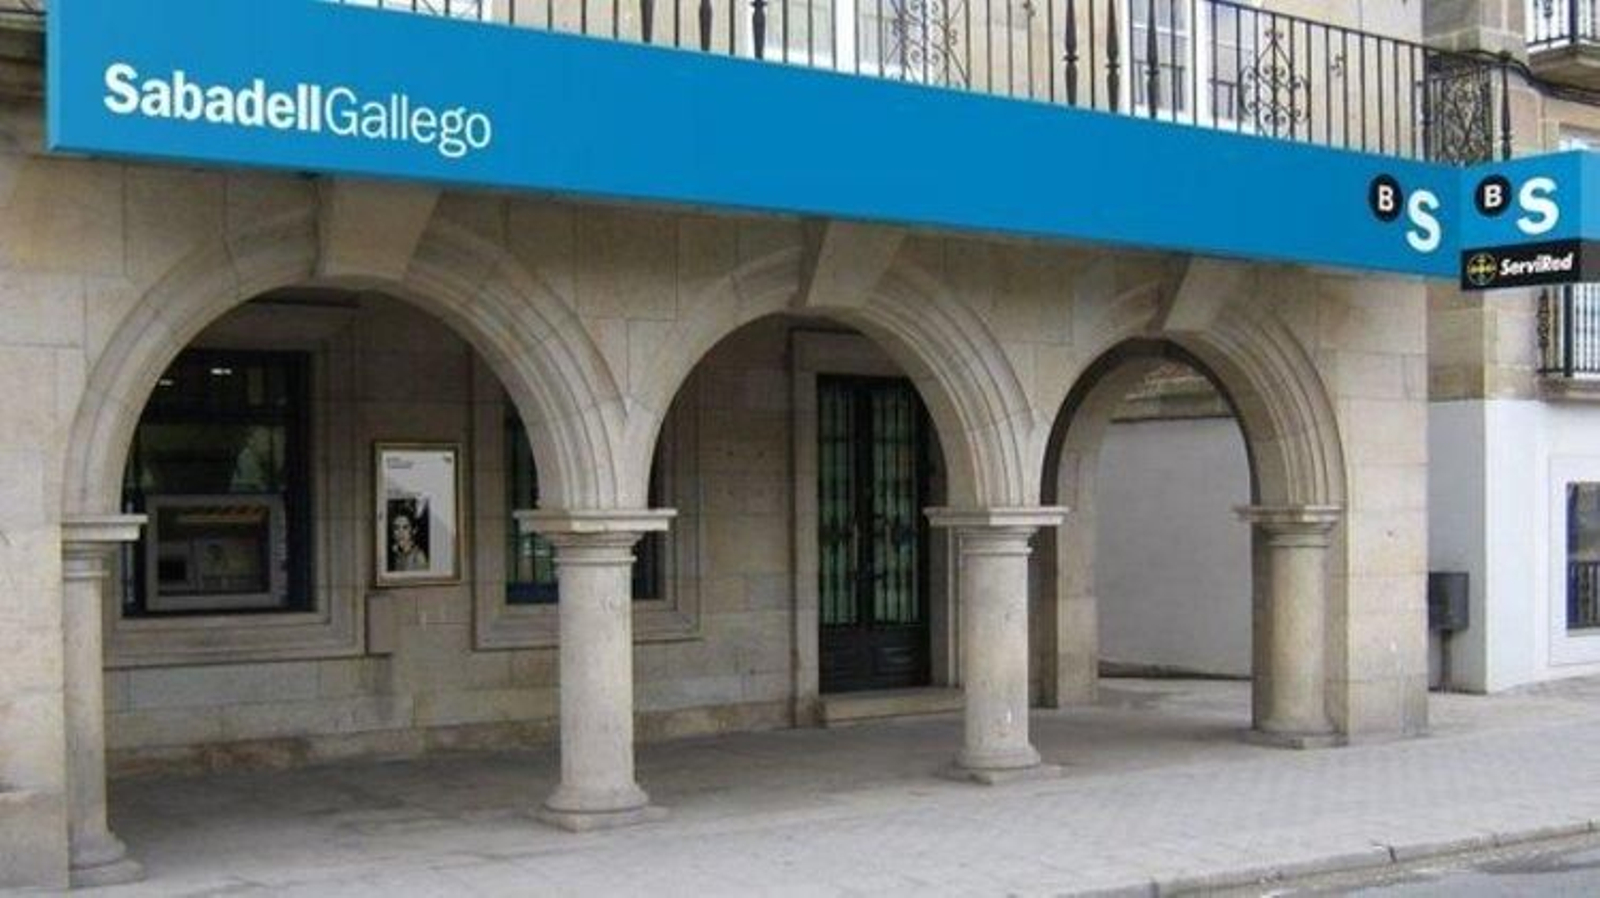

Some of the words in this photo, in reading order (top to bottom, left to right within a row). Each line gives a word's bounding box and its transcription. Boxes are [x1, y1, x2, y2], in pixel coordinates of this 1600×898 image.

[1377, 184, 1394, 211] B
[1406, 188, 1442, 252] S
[1483, 184, 1503, 208] B
[1516, 176, 1560, 235] S
[1499, 252, 1574, 276] ServiRed
